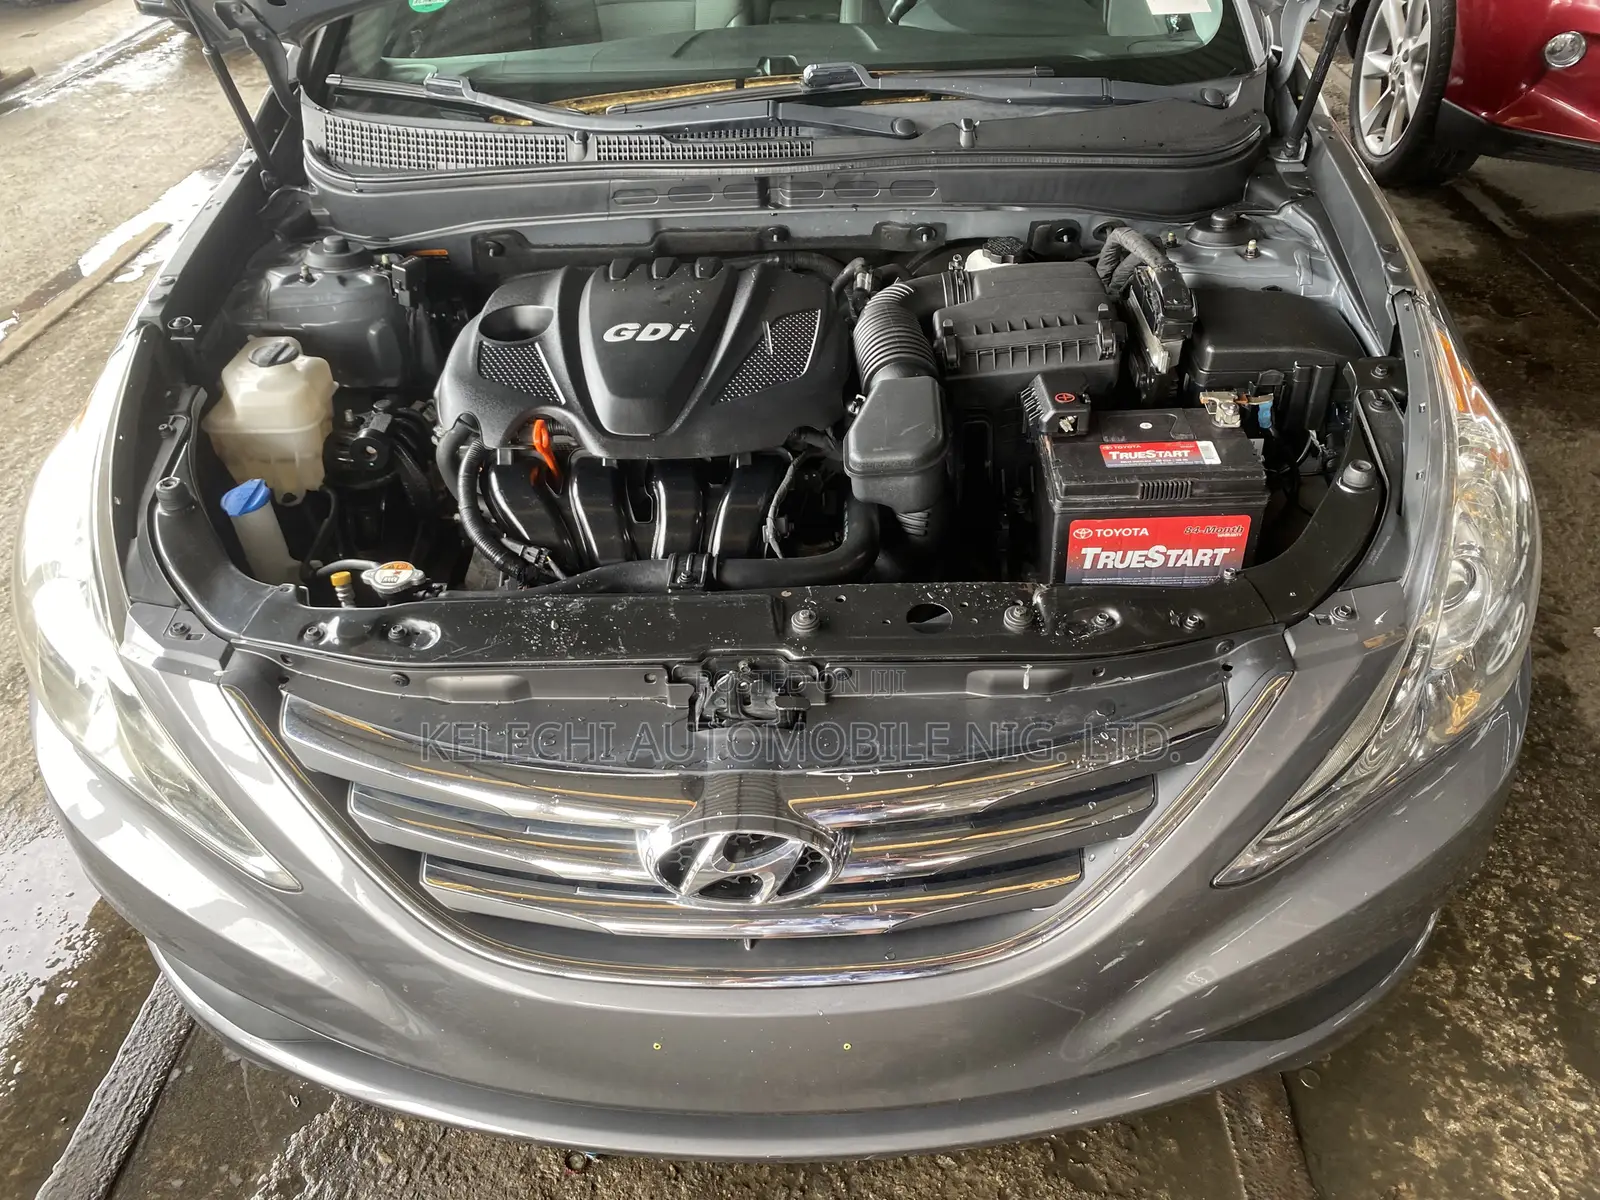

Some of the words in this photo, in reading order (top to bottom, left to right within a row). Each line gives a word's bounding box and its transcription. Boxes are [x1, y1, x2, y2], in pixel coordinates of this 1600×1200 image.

[603, 323, 691, 342] GDi
[1095, 527, 1149, 537] TOYOTA
[1184, 525, 1244, 535] 84-Month
